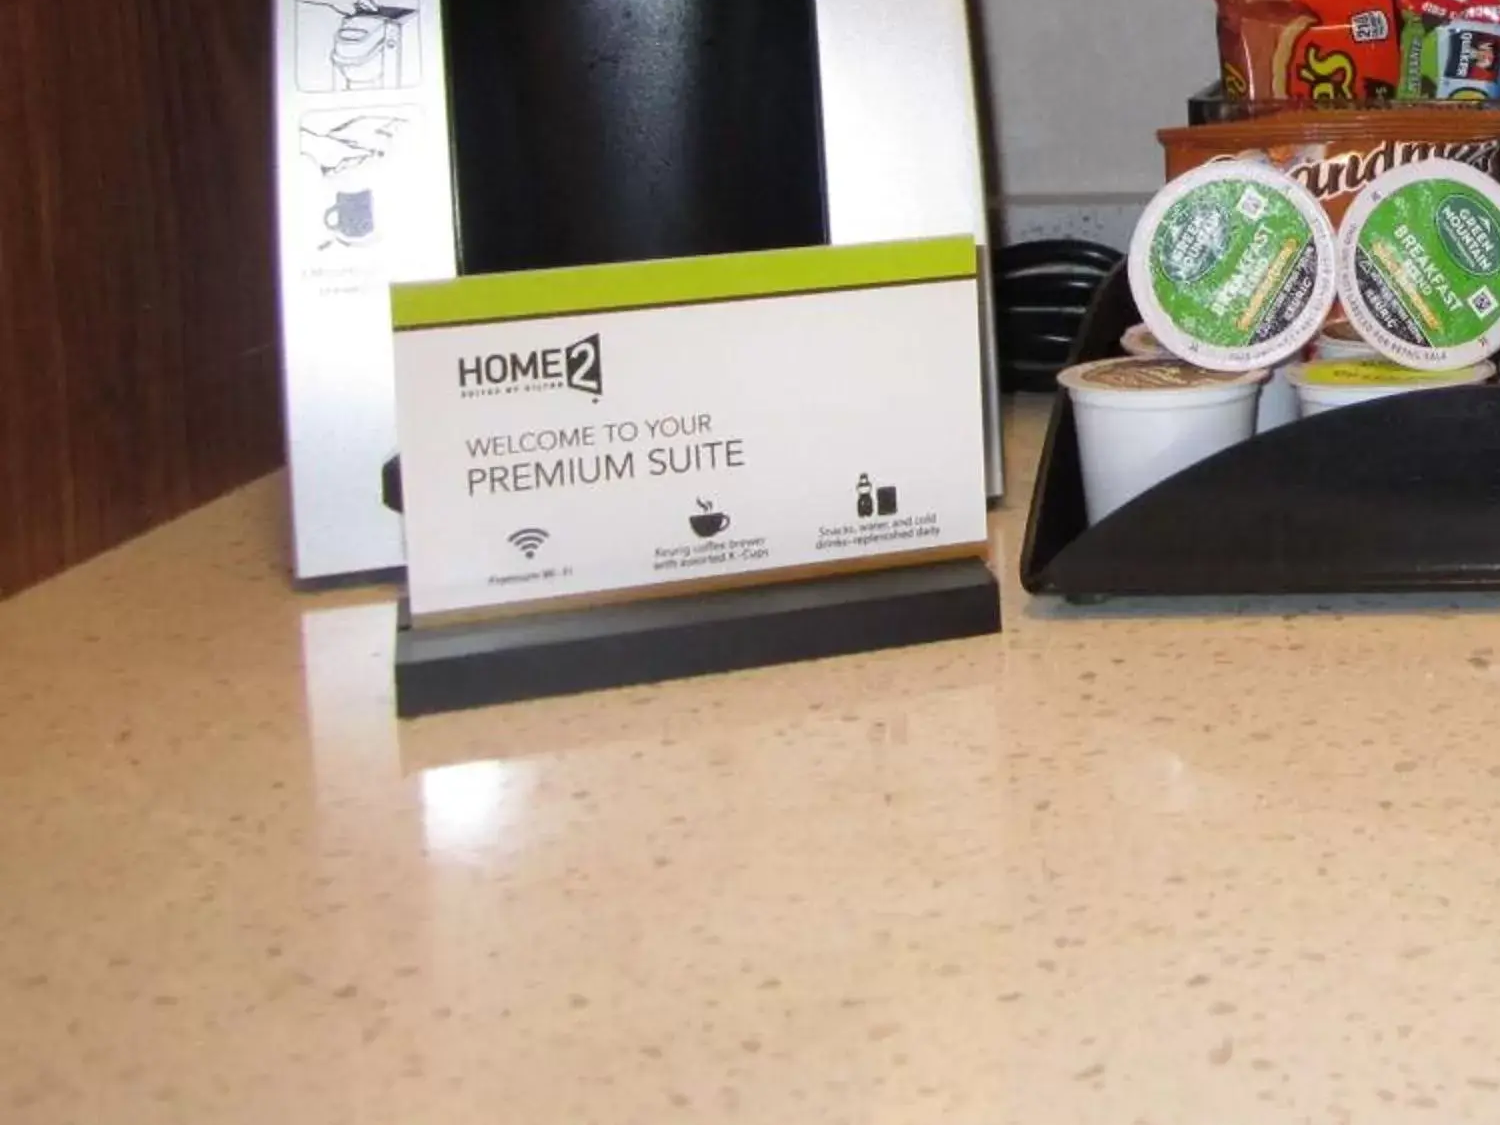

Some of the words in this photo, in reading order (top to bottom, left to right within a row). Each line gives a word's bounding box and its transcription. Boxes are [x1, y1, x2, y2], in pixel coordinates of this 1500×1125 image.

[1456, 32, 1474, 78] QUAKER
[1441, 206, 1493, 272] MOUNTAIN
[1458, 207, 1497, 253] GREEN
[1393, 225, 1464, 312] BREAKFAST
[466, 426, 596, 458] WELCOME
[604, 421, 639, 444] TO
[645, 414, 712, 439] YOUR
[467, 452, 636, 497] PREMIUM
[648, 439, 746, 476] SUITE
[655, 546, 691, 559] Keurig
